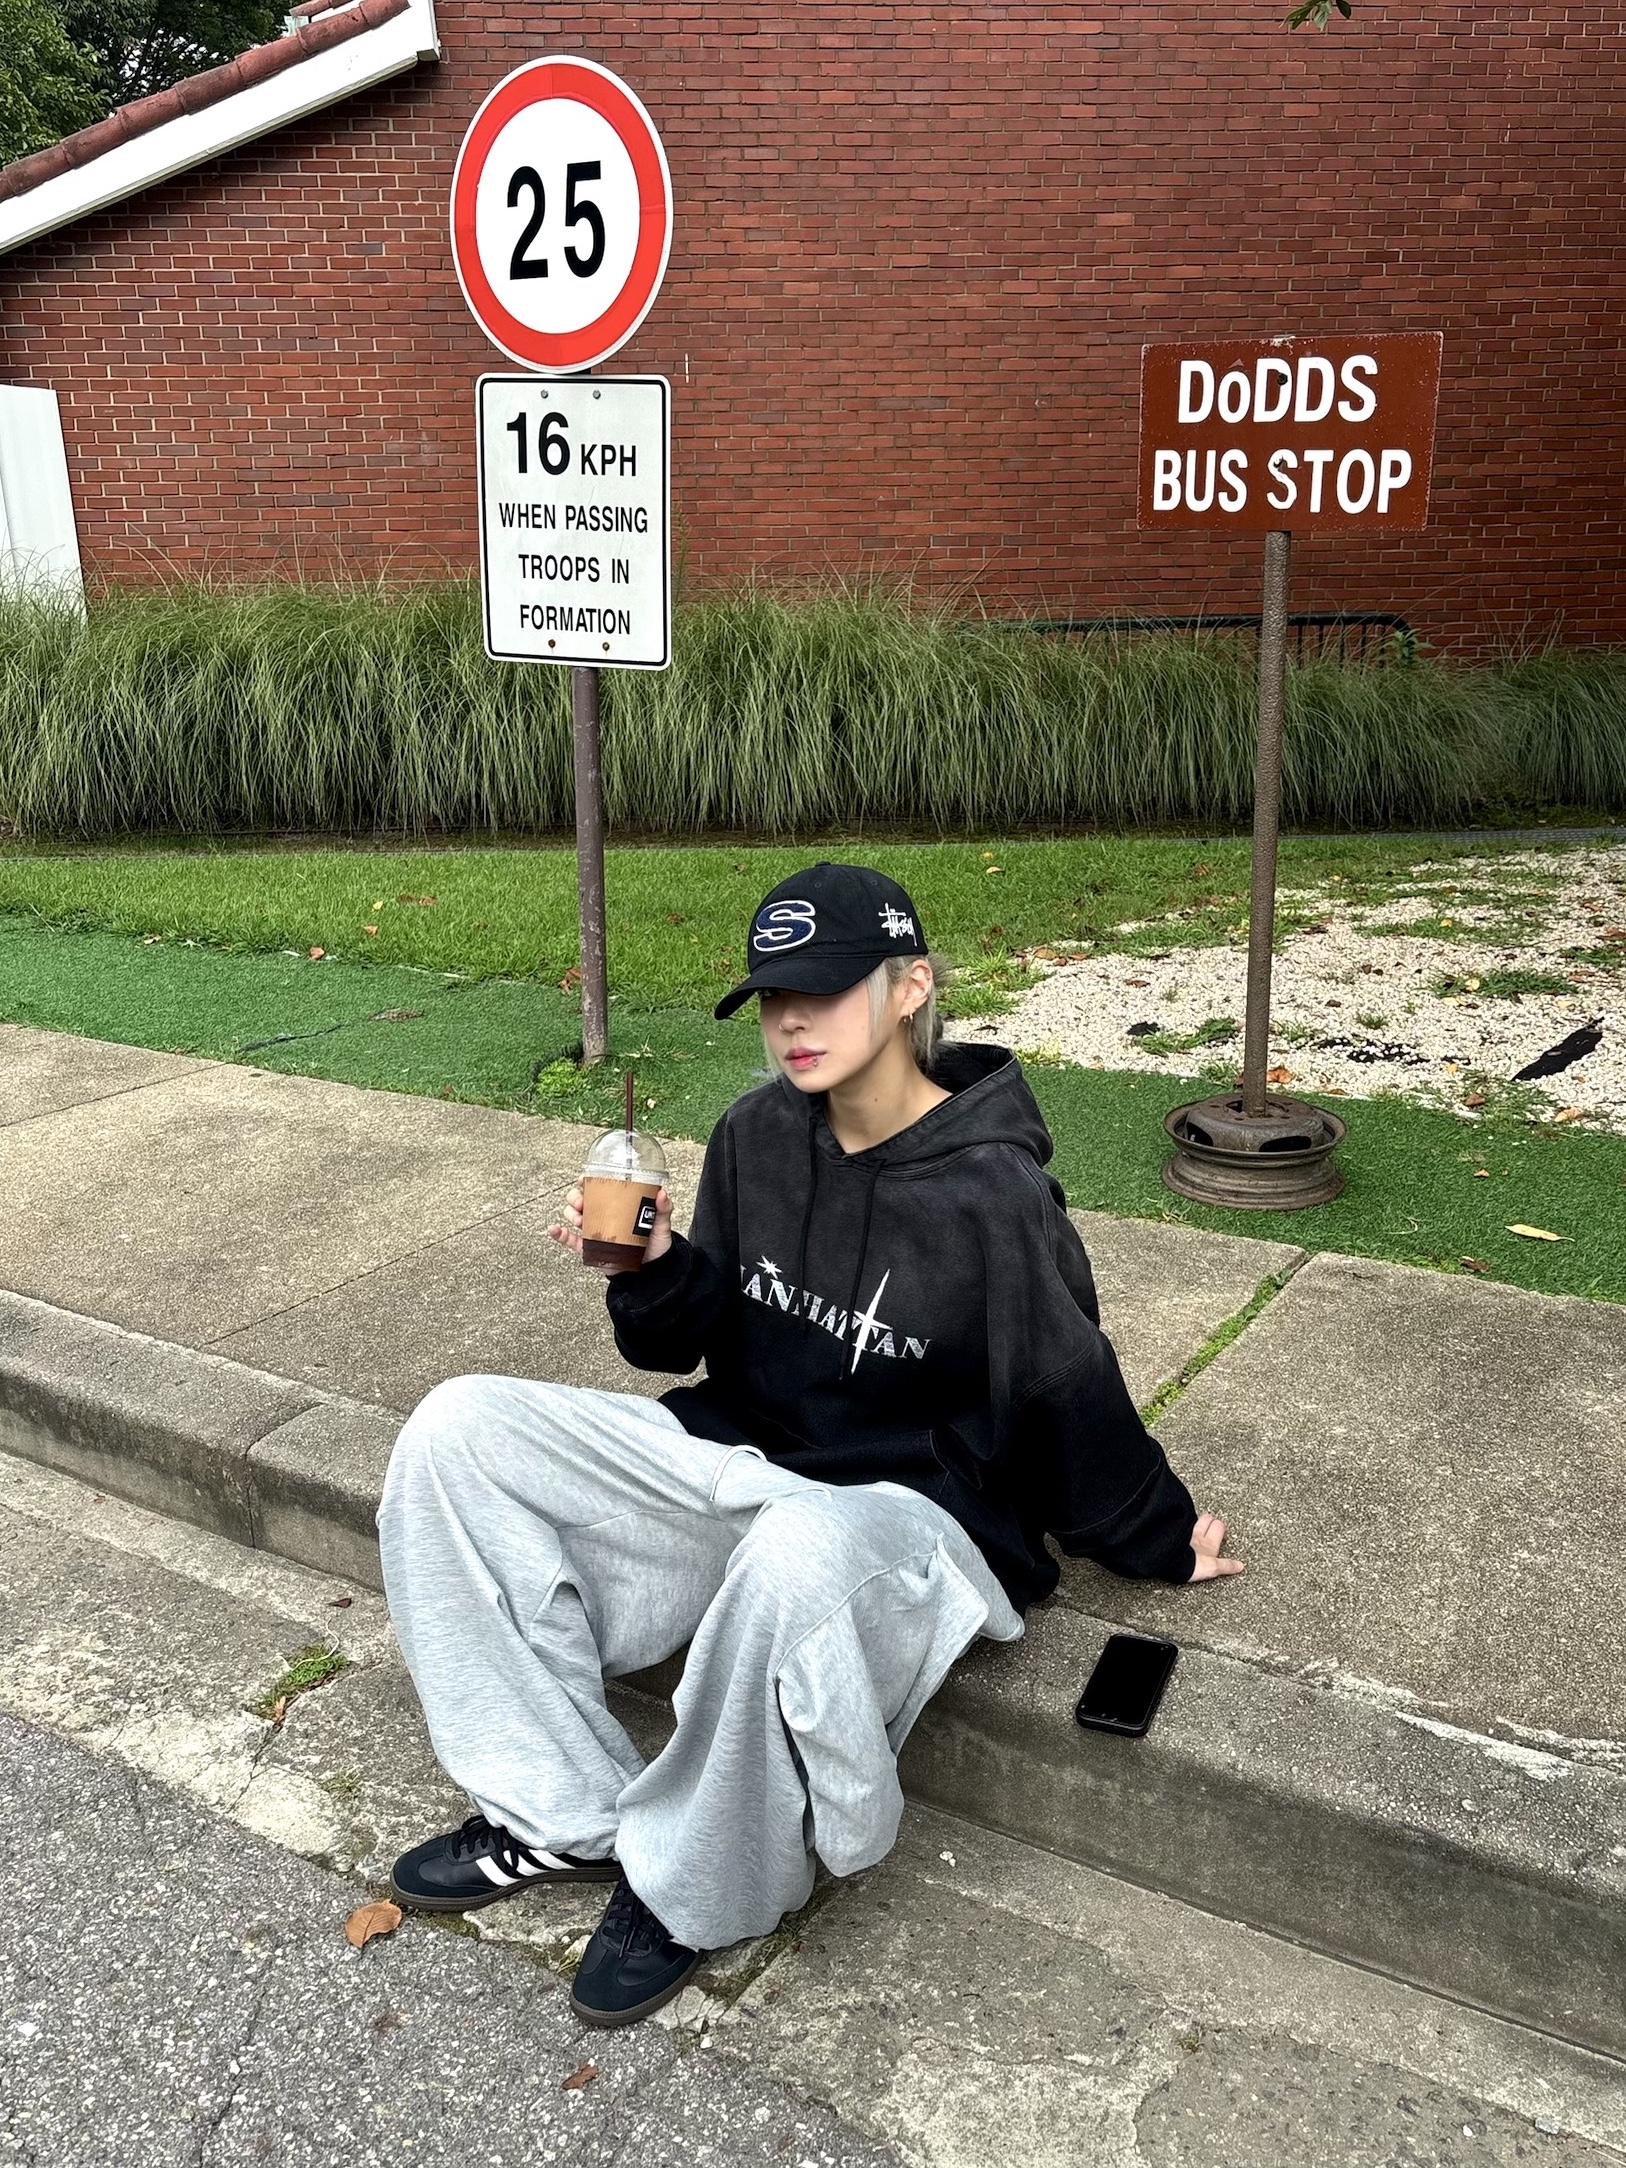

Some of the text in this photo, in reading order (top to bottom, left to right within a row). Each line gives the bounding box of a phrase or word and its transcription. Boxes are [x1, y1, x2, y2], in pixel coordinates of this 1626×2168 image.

[507, 160, 606, 281] 25
[1178, 354, 1379, 424] DoDDS
[506, 411, 637, 478] 16 KPH
[1153, 448, 1412, 514] BUS STOP
[498, 502, 649, 534] WHEN PASSING
[518, 553, 630, 585] TROOPS IN
[520, 604, 631, 635] FORMATION
[753, 899, 816, 952] S
[740, 1264, 932, 1360] ANHATTAN
